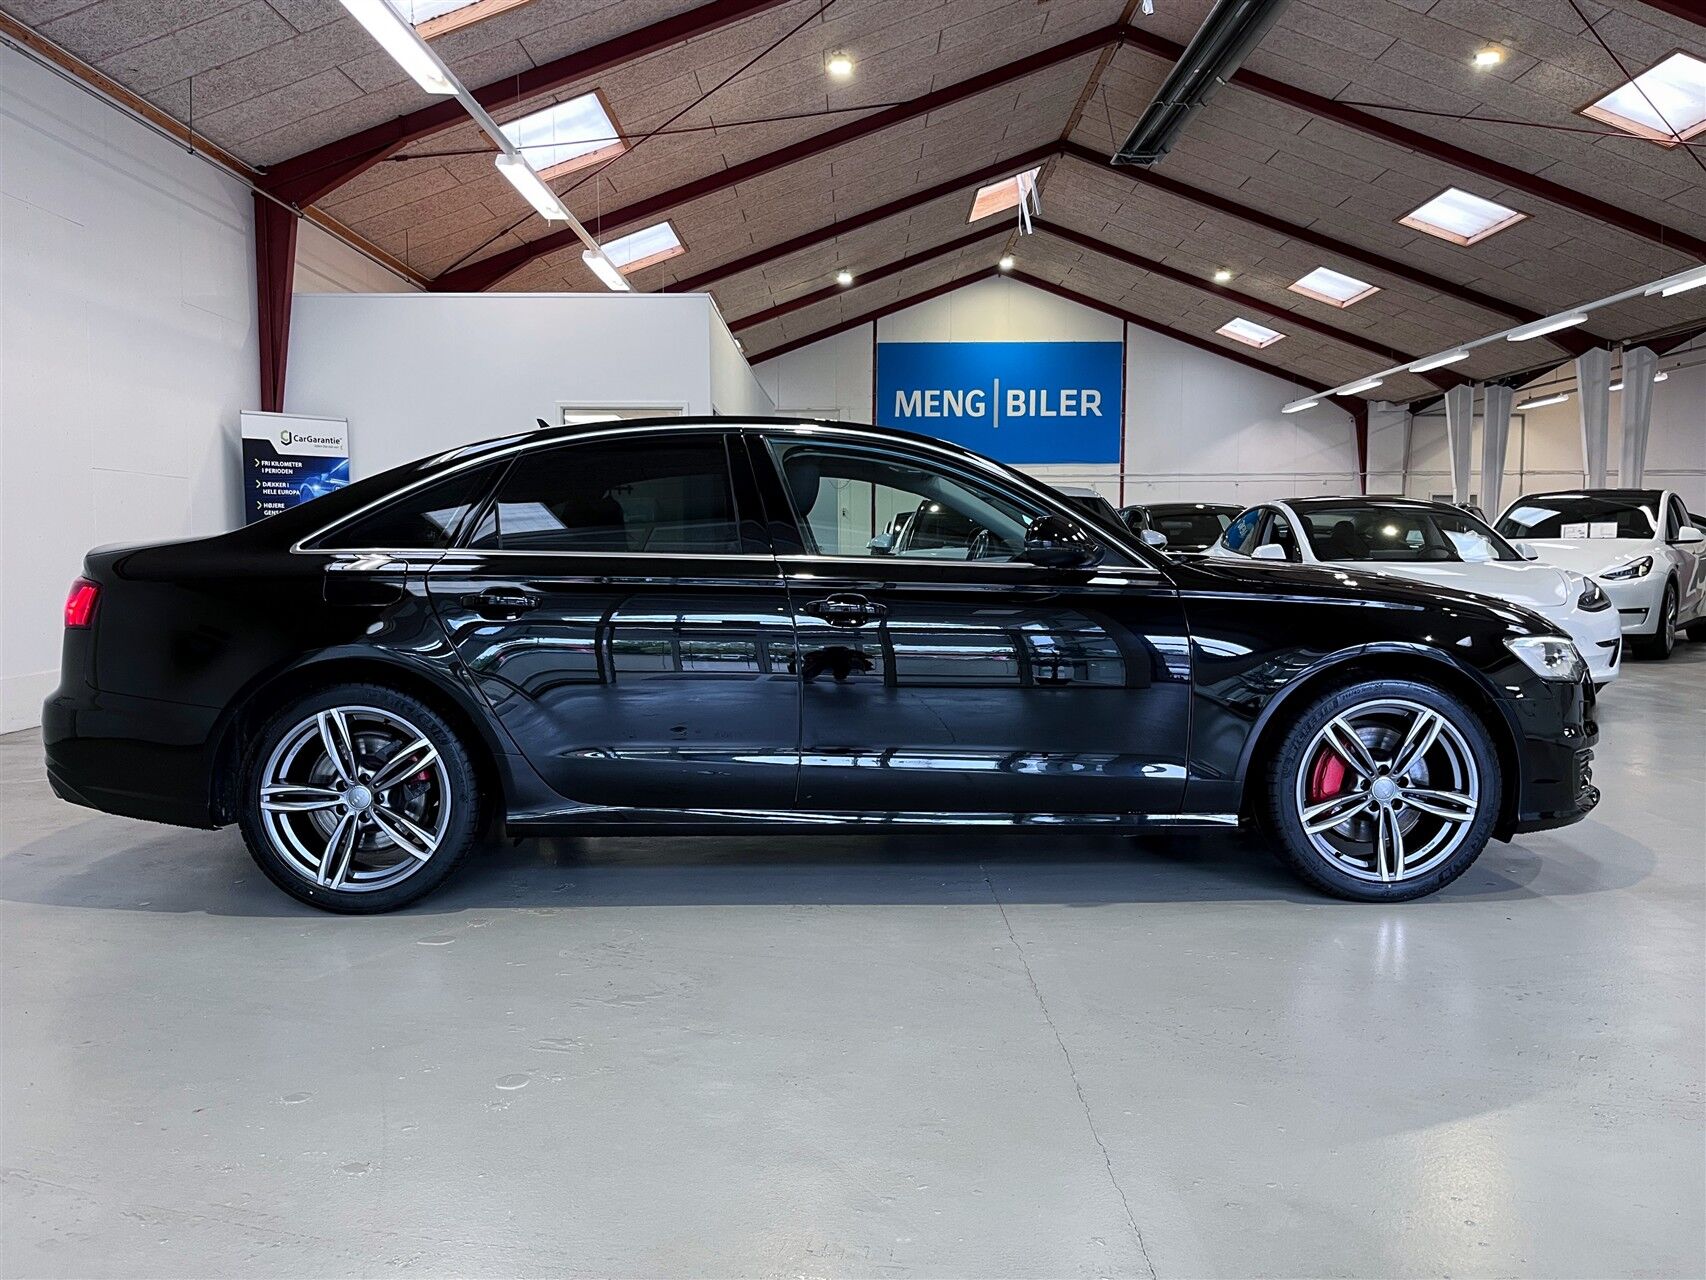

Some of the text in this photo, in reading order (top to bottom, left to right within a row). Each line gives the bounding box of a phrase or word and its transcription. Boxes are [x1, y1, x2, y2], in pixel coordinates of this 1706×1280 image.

[894, 389, 1103, 418] MENG BILER
[293, 434, 341, 445] CarGarantie
